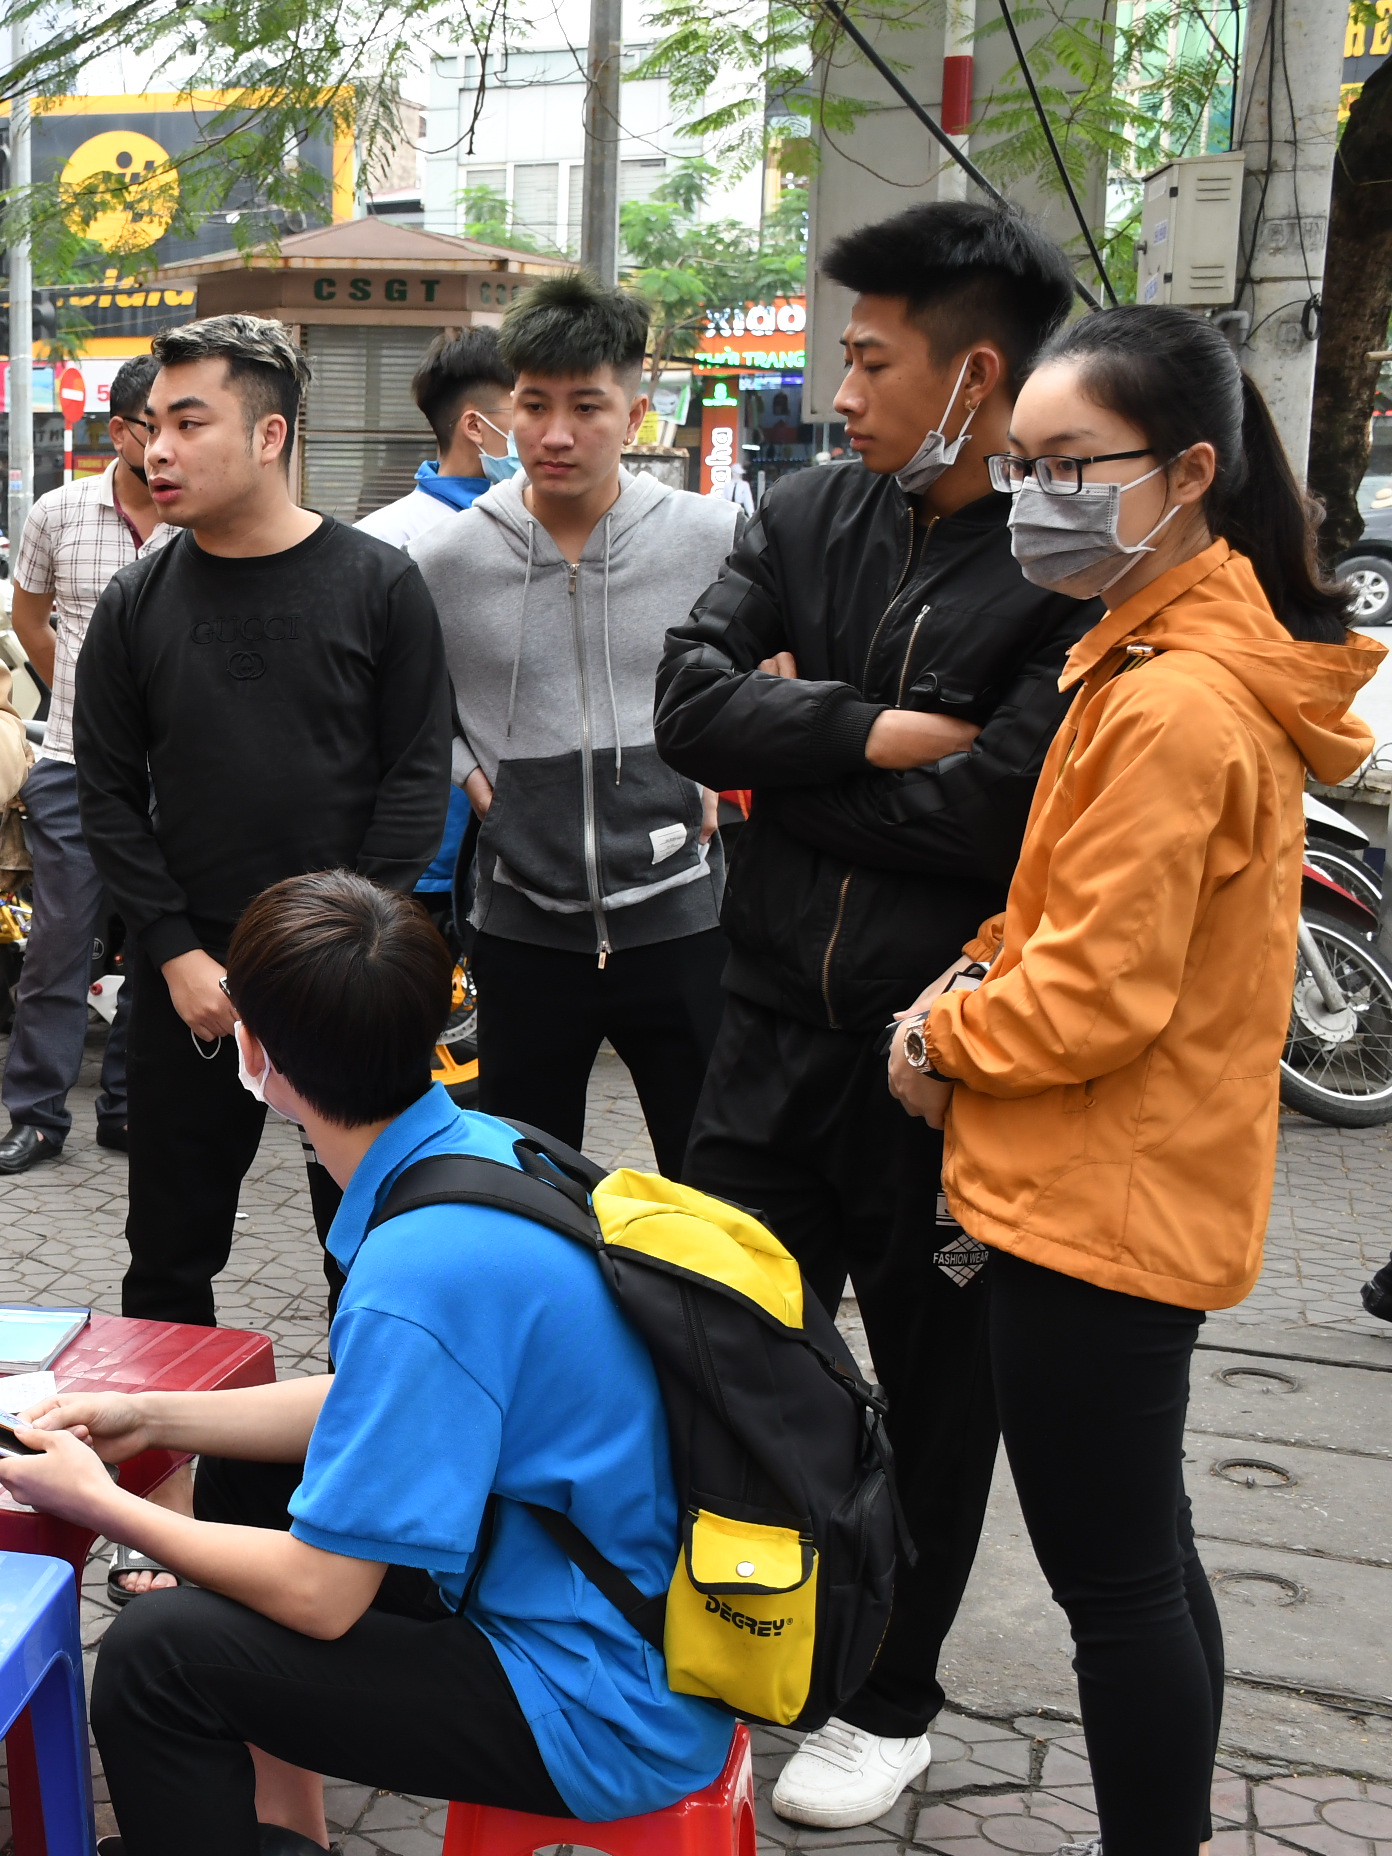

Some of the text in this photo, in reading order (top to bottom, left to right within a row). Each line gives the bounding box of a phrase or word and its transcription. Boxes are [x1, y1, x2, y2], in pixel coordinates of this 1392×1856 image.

[313, 277, 442, 303] CSGT
[741, 350, 806, 369] TRANG
[190, 615, 305, 645] GUCCI
[933, 1251, 989, 1265] FASHION WEAR
[705, 1594, 785, 1637] DEGREY
